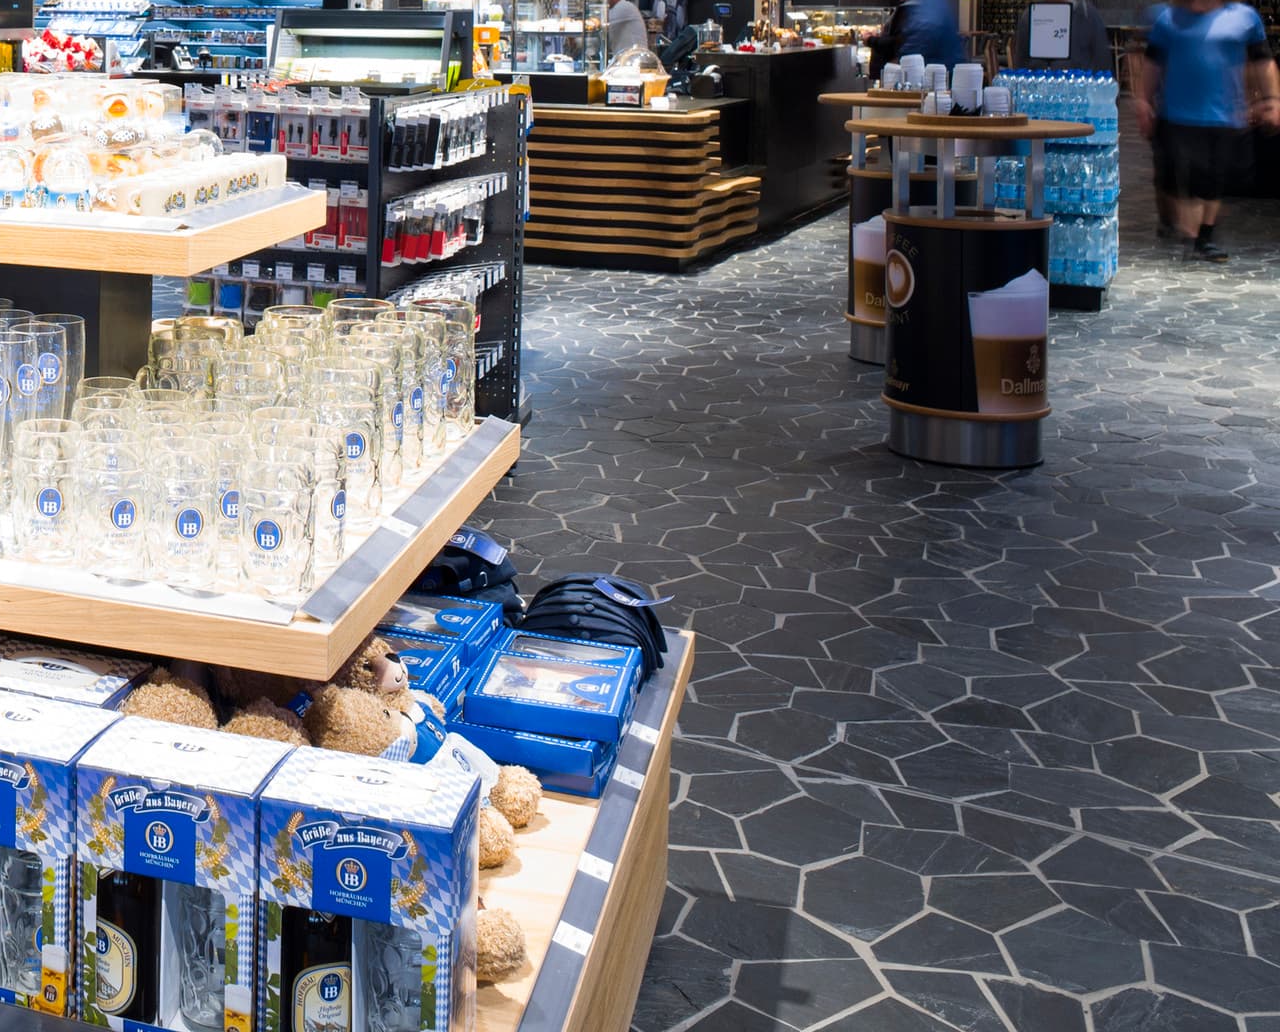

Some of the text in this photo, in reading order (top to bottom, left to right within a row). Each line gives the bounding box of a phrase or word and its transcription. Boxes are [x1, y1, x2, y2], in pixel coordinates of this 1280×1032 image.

[43, 368, 56, 378] HB
[22, 379, 34, 391] HB
[348, 446, 360, 456] HB
[44, 502, 58, 513] HB
[118, 514, 132, 526] HB
[183, 523, 198, 535] HB
[261, 535, 276, 547] HB
[114, 790, 198, 814] Grüße aus Bayern
[152, 836, 166, 849] HB
[303, 826, 395, 850] Grüße aus Bayern
[144, 858, 174, 869] MÜNCHEN
[344, 872, 359, 887] HB
[335, 898, 368, 908] MÜNCHEN
[324, 986, 338, 999] HB
